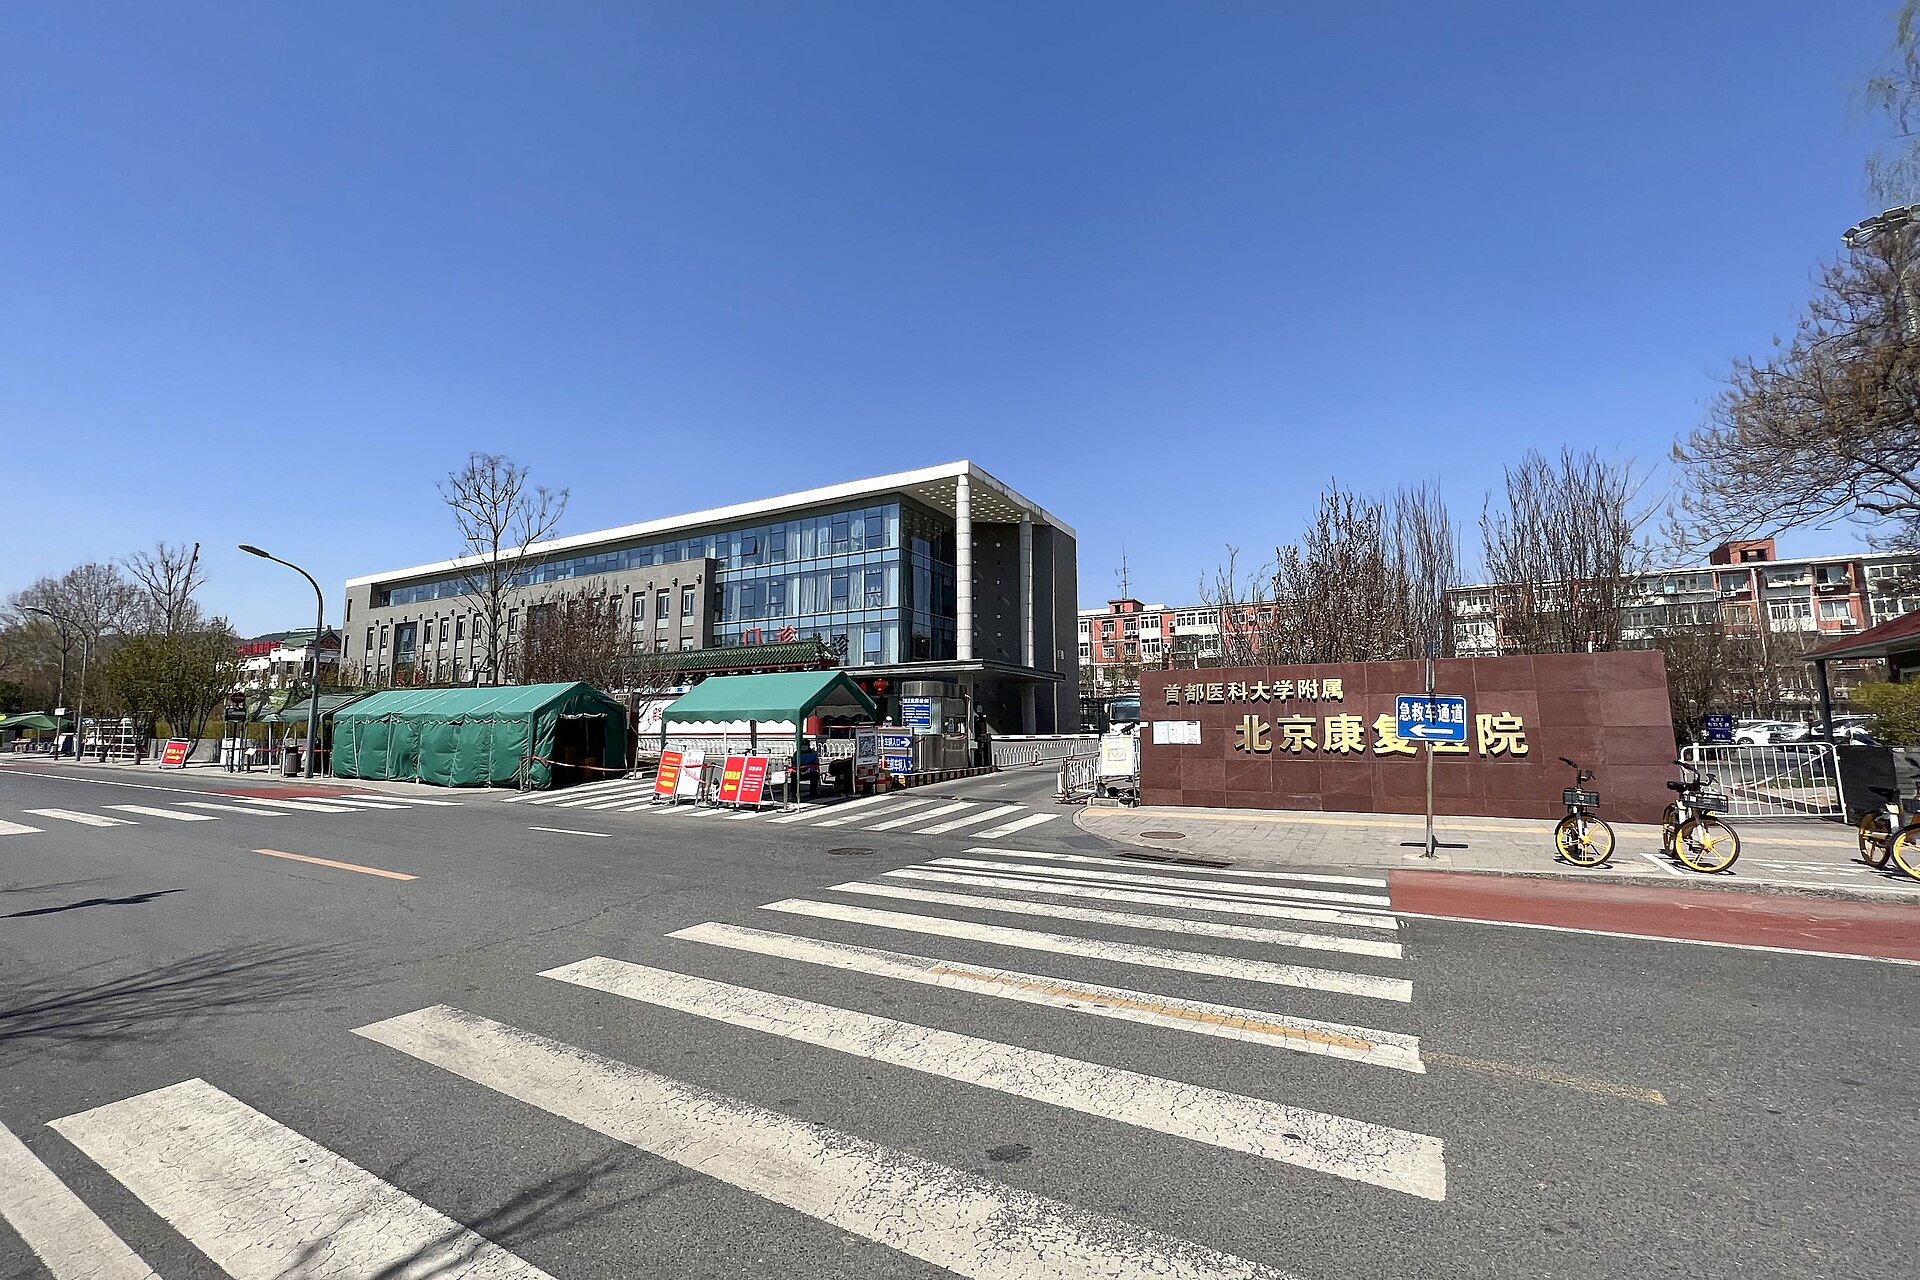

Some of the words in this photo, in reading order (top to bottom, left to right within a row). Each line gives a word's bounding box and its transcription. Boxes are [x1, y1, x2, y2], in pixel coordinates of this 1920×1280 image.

[742, 624, 798, 646] 门诊
[1163, 678, 1344, 703] 首都医科大学附属
[1399, 702, 1464, 723] 急救车通道
[1234, 712, 1529, 755] 北京康复院
